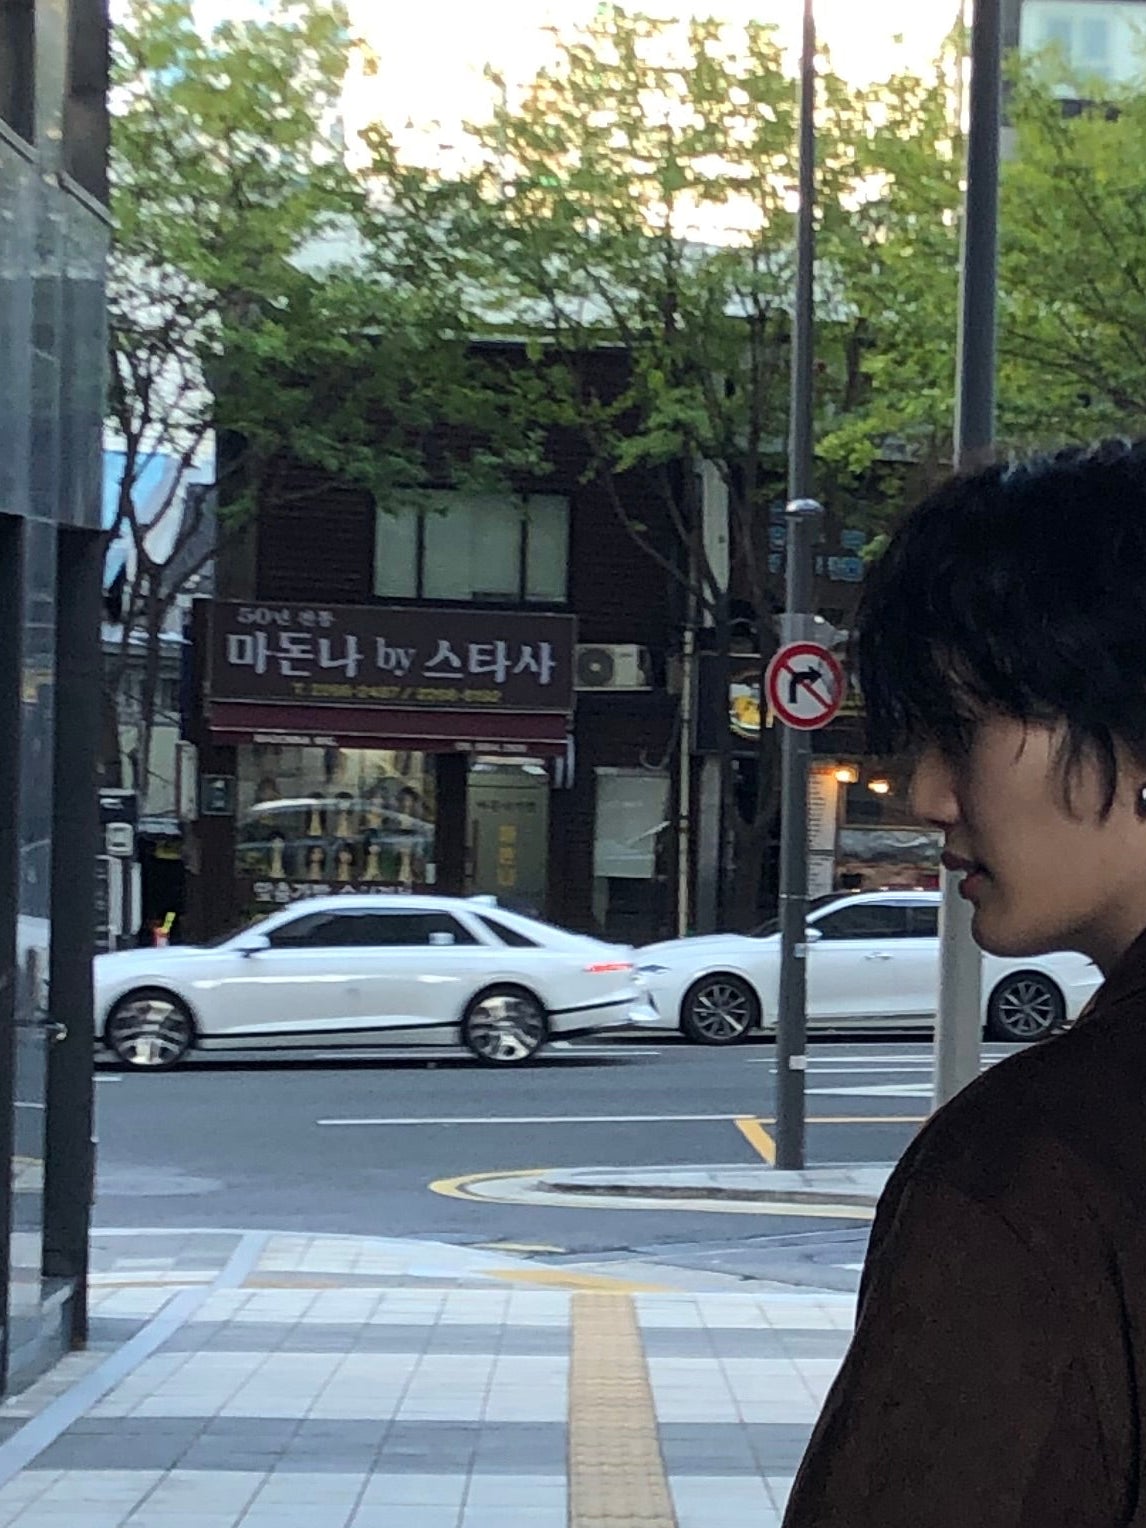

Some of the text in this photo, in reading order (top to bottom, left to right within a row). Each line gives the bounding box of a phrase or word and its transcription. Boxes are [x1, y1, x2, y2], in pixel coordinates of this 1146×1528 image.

[227, 631, 556, 685] 마돈나 by 스타사
